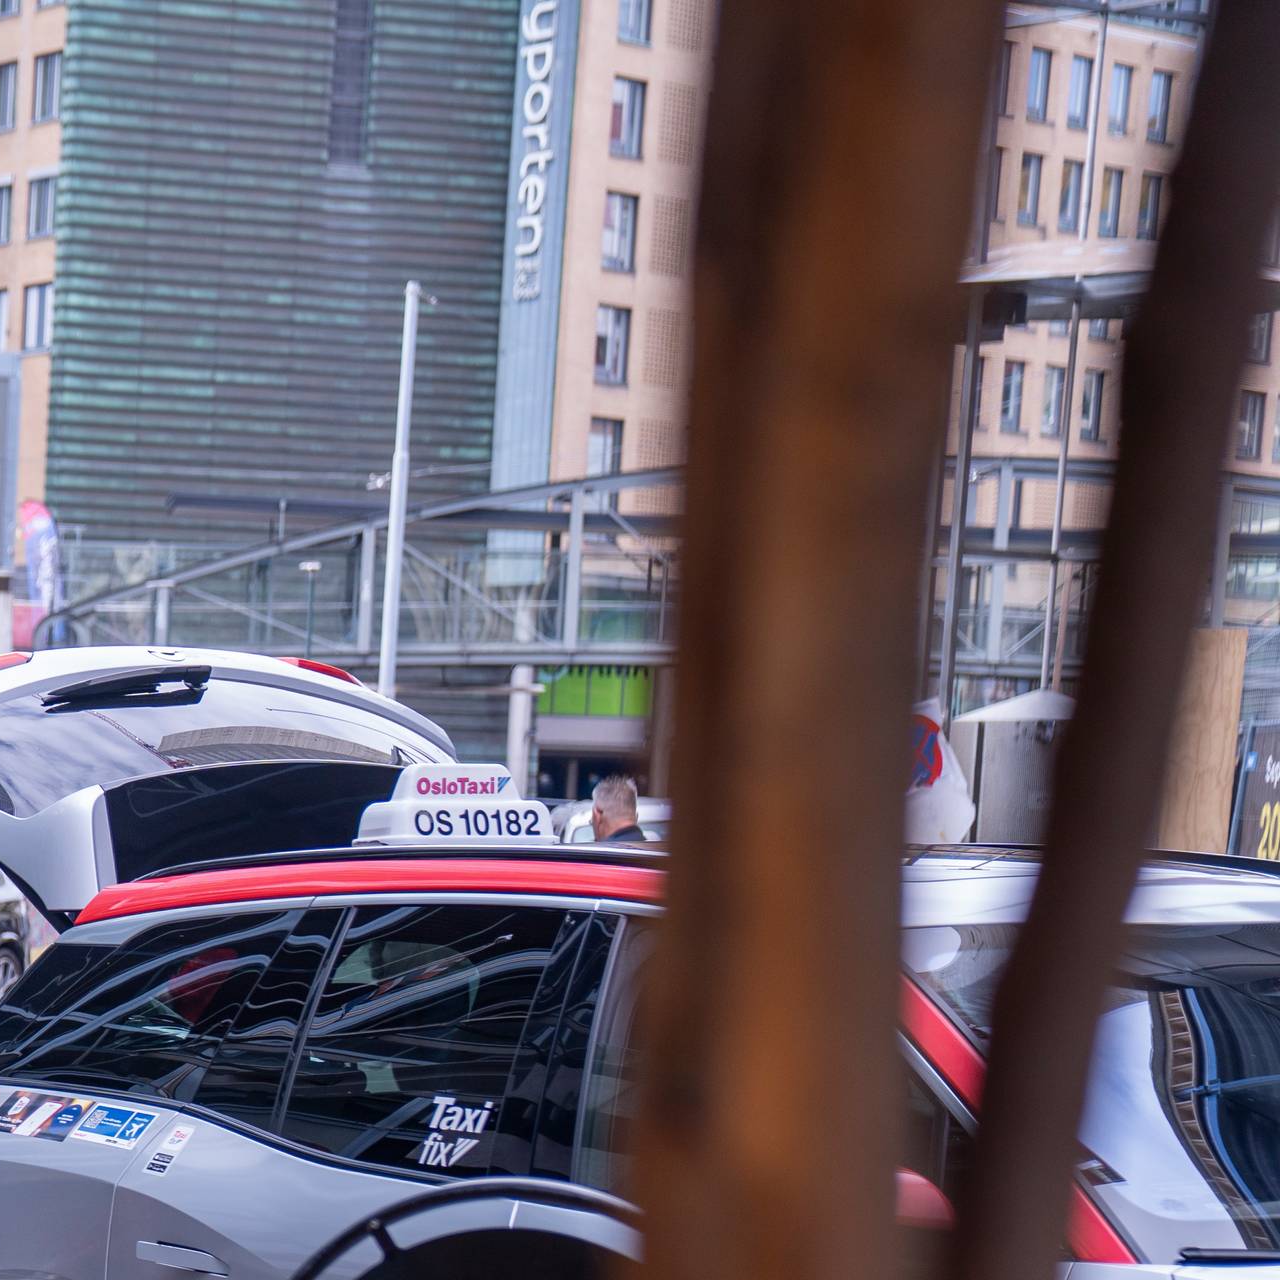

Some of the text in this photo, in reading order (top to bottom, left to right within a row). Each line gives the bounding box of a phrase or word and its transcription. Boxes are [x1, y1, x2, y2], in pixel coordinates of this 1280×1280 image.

[416, 776, 496, 795] OsloTaxi
[414, 808, 541, 836] OS 10182
[428, 1095, 495, 1134] Taxi
[418, 1132, 456, 1168] fix
